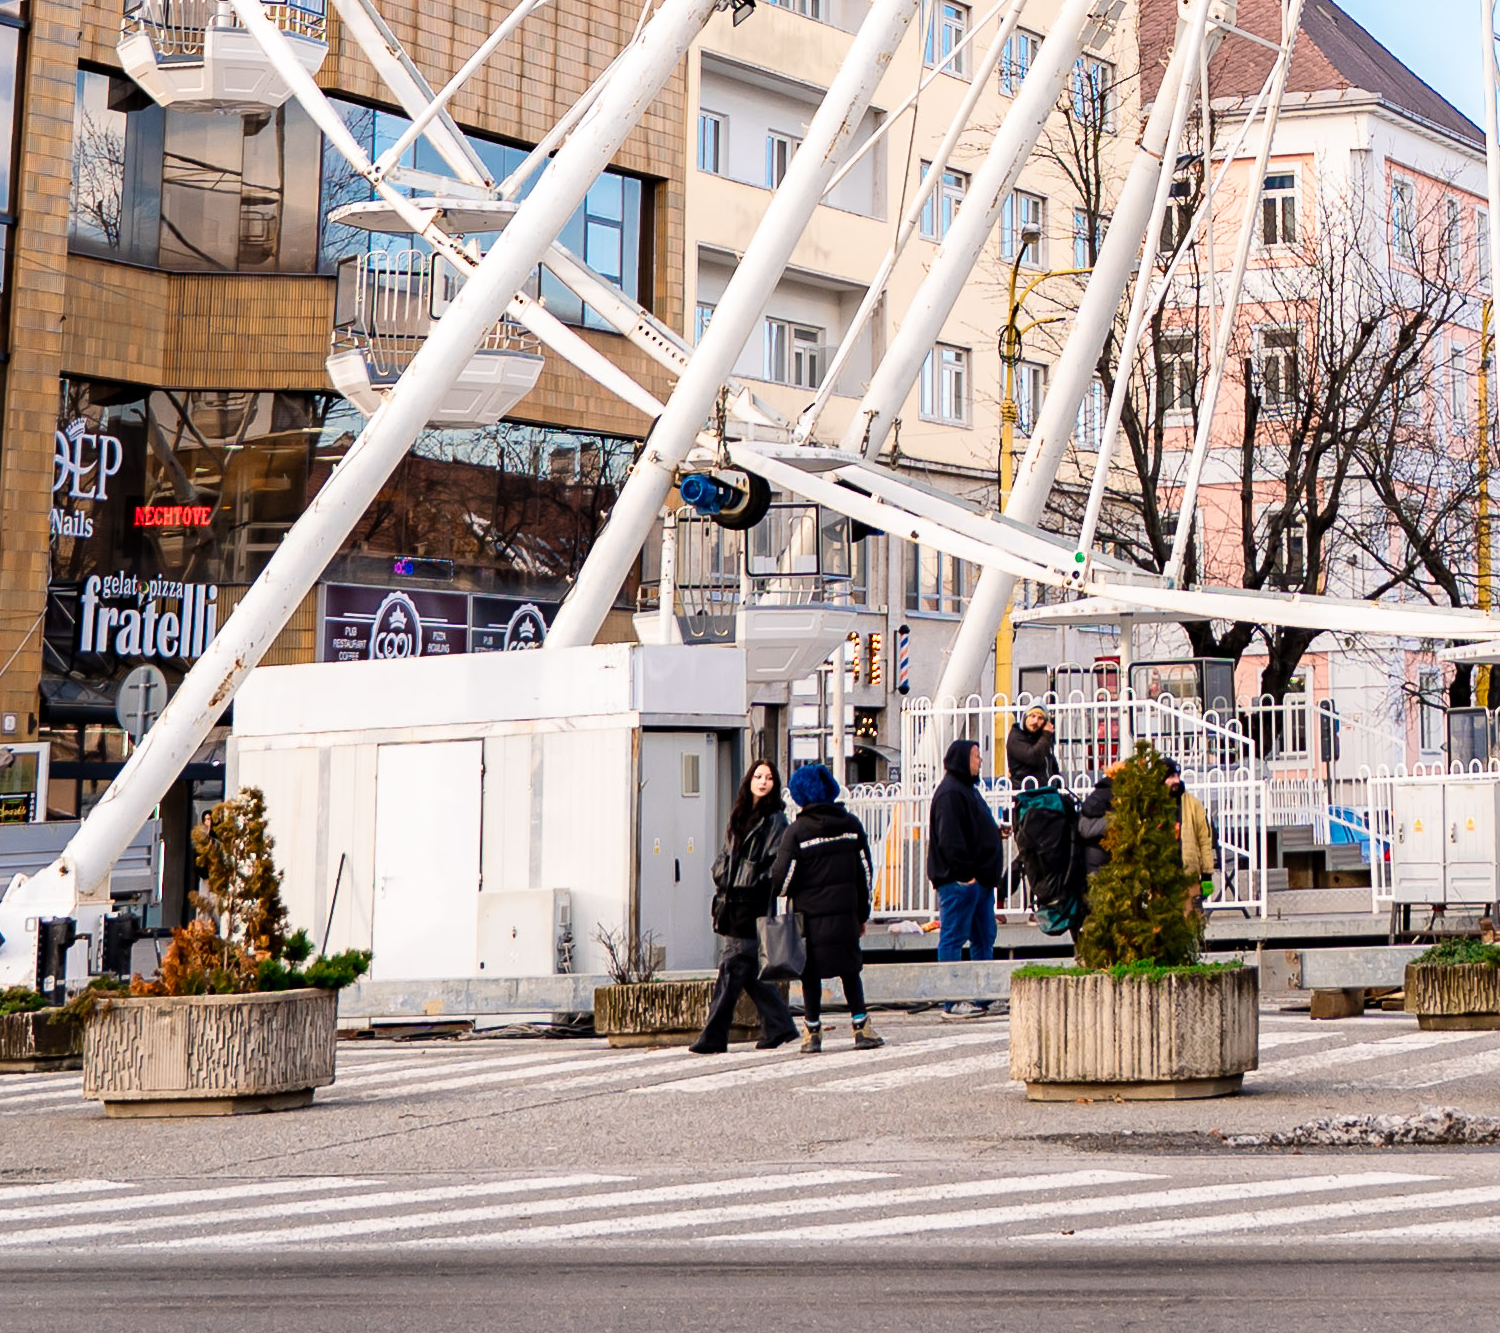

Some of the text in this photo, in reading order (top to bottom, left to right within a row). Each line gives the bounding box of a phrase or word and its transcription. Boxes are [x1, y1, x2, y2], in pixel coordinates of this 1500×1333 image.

[49, 508, 94, 538] Nails
[148, 574, 184, 601] pizza
[80, 575, 218, 658] fratelli
